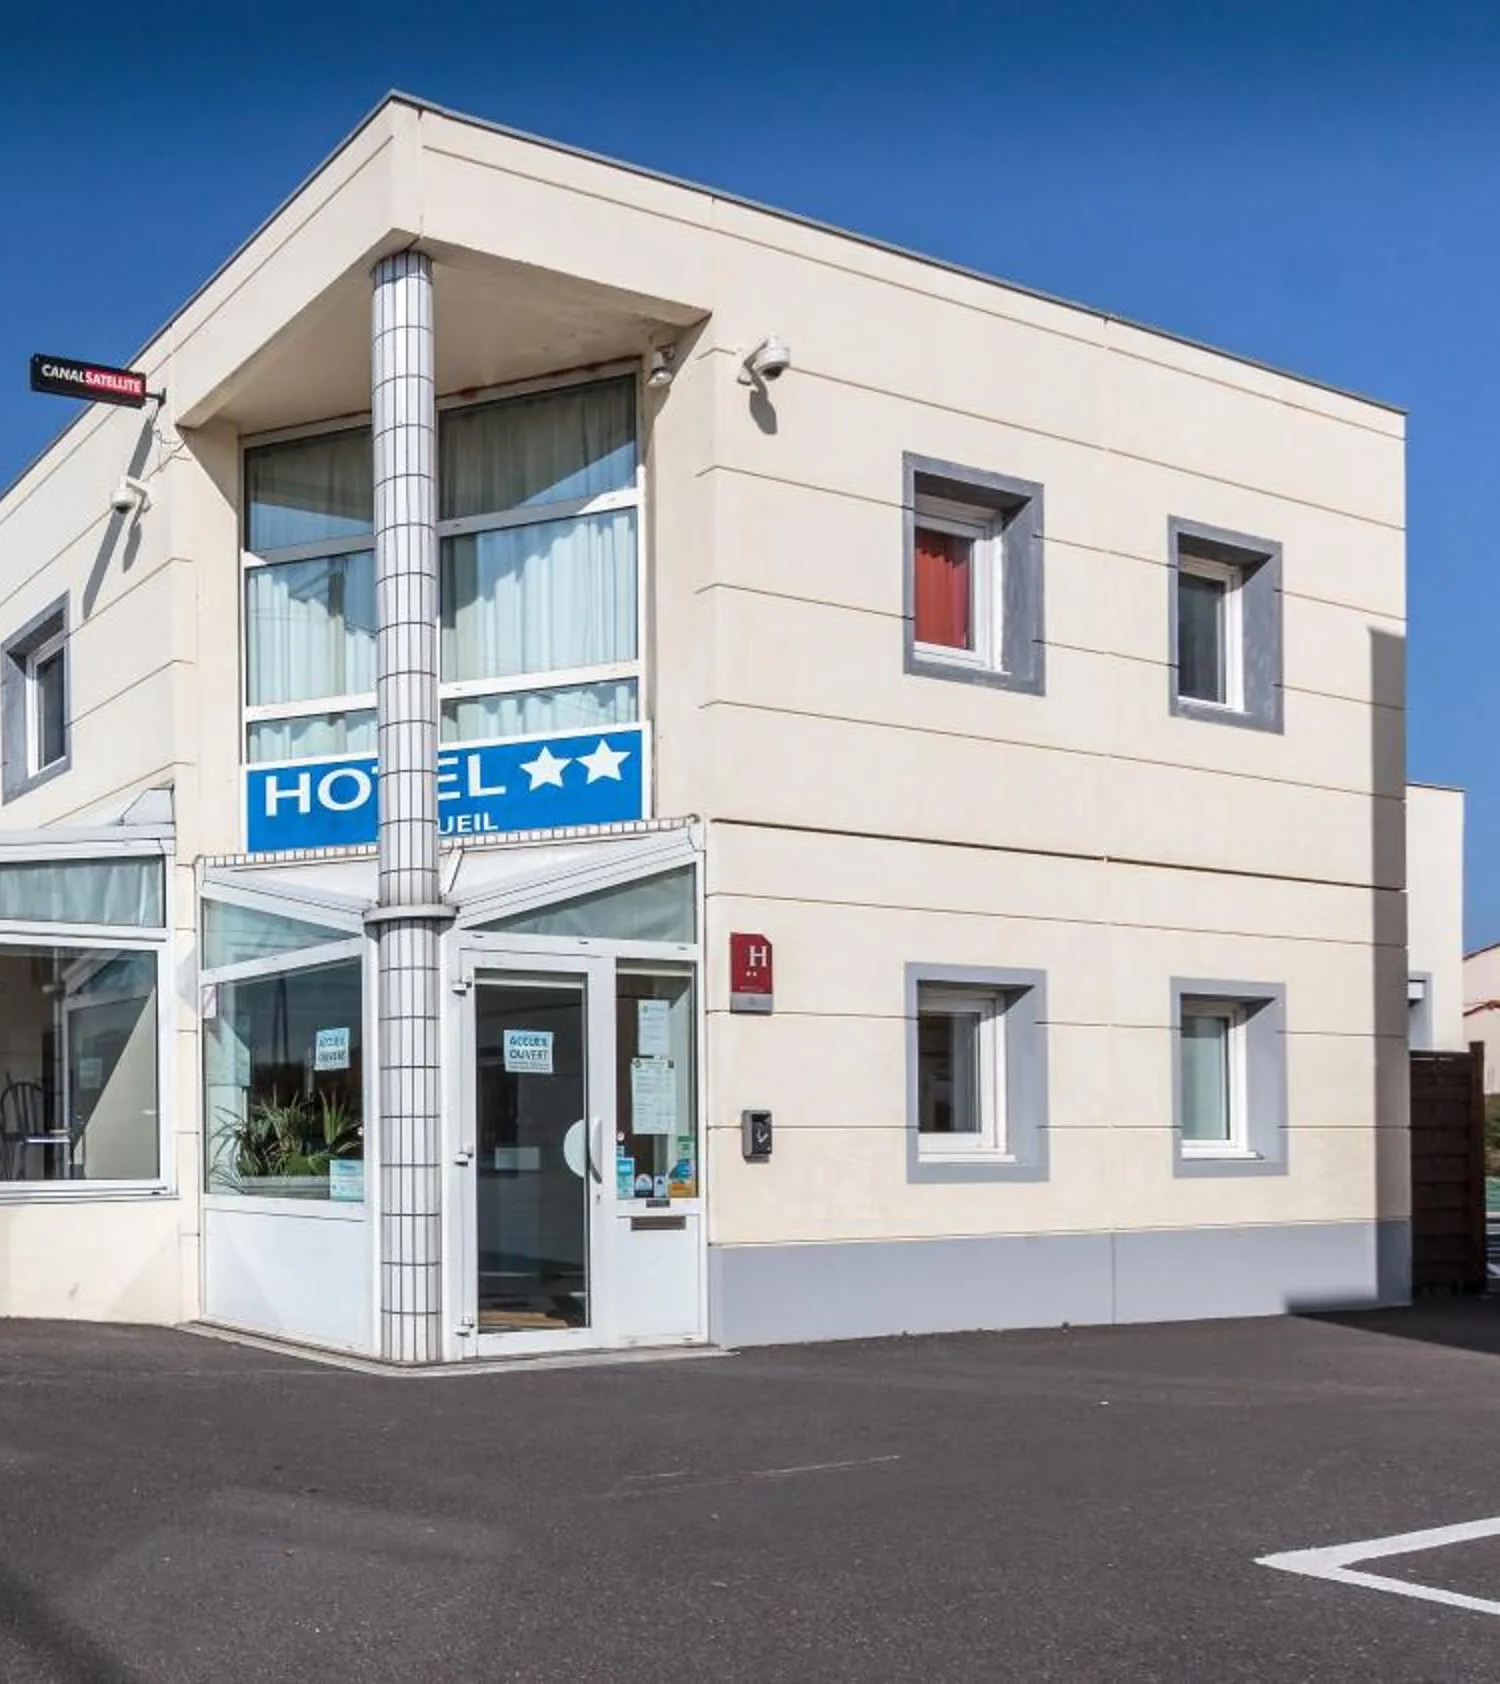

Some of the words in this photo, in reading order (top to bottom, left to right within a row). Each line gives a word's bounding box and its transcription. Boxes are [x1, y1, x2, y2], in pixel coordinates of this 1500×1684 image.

[264, 753, 506, 817] HOEL
[437, 812, 499, 835] UEIL
[748, 944, 768, 968] H
